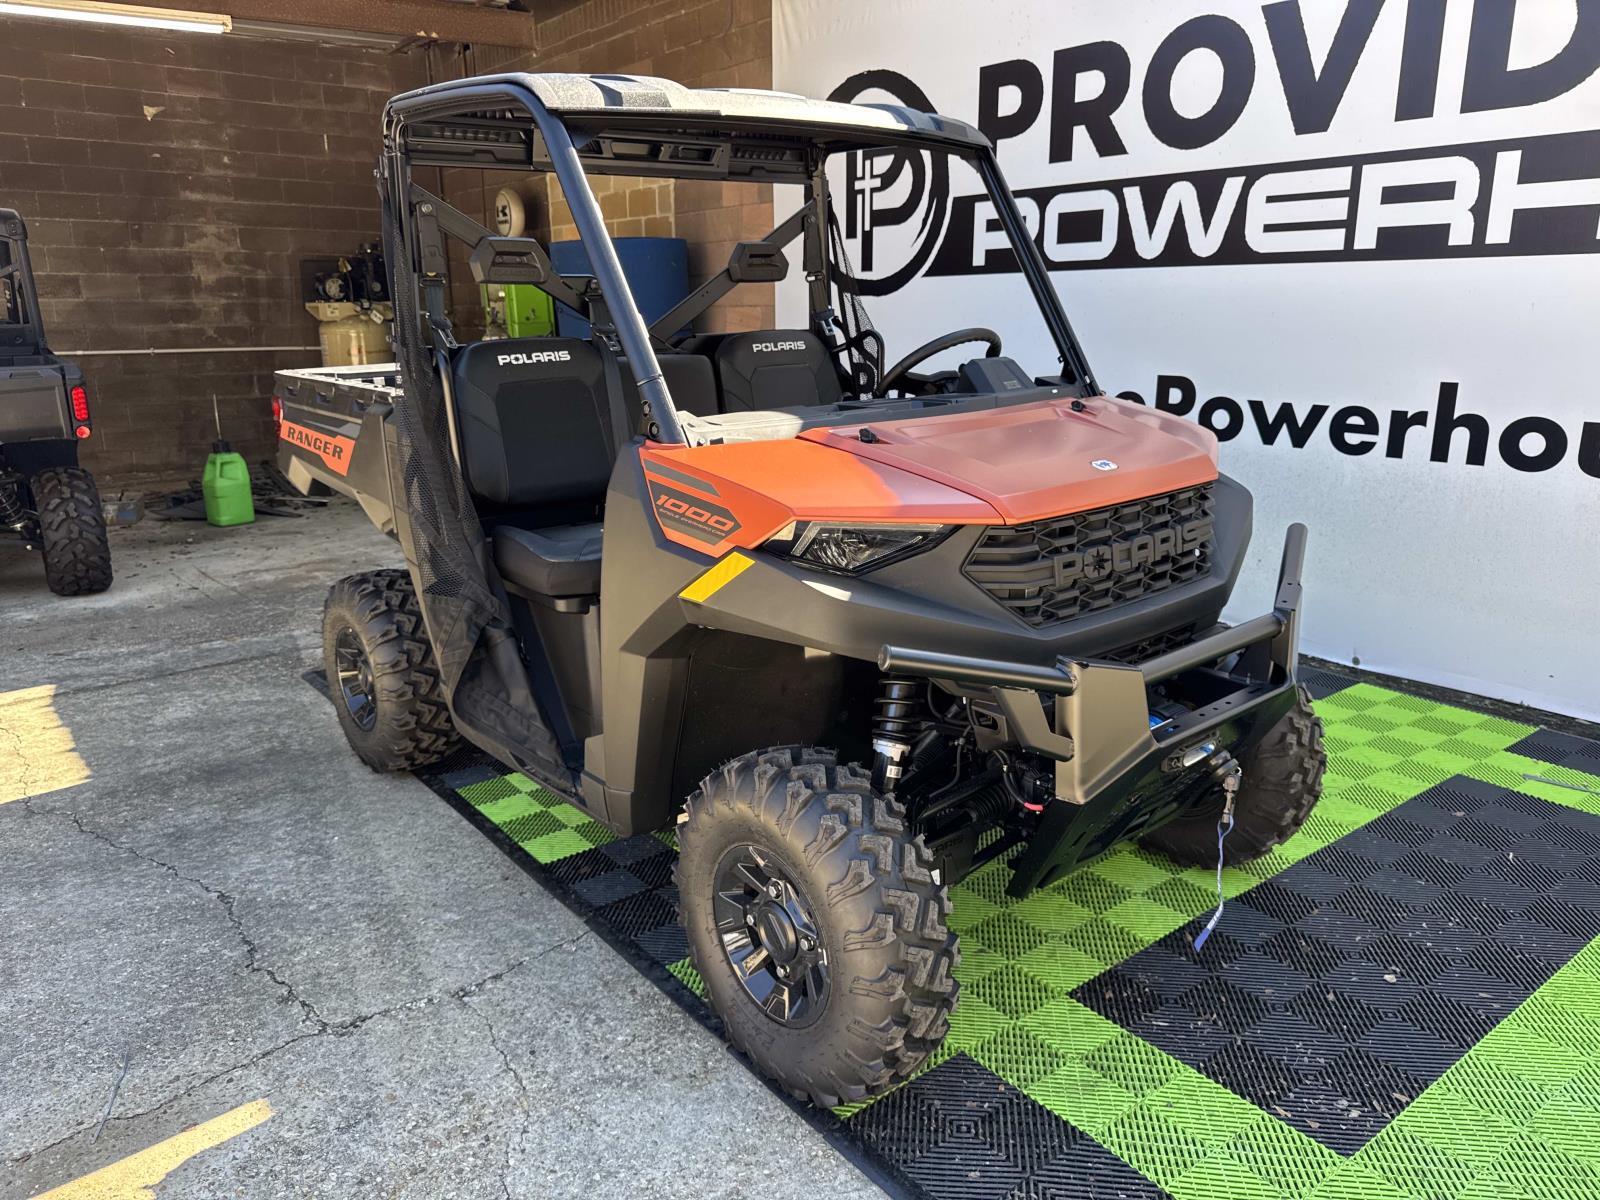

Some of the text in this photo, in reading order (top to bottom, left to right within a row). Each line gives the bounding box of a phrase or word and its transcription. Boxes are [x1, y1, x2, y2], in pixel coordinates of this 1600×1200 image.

[977, 0, 1600, 164] PROVID
[972, 149, 1600, 267] POWERH
[497, 350, 571, 366] POLARIS
[752, 341, 806, 353] POLARIS
[287, 426, 344, 460] RANGER
[656, 494, 735, 531] 1000
[1054, 519, 1200, 588] POLARIS
